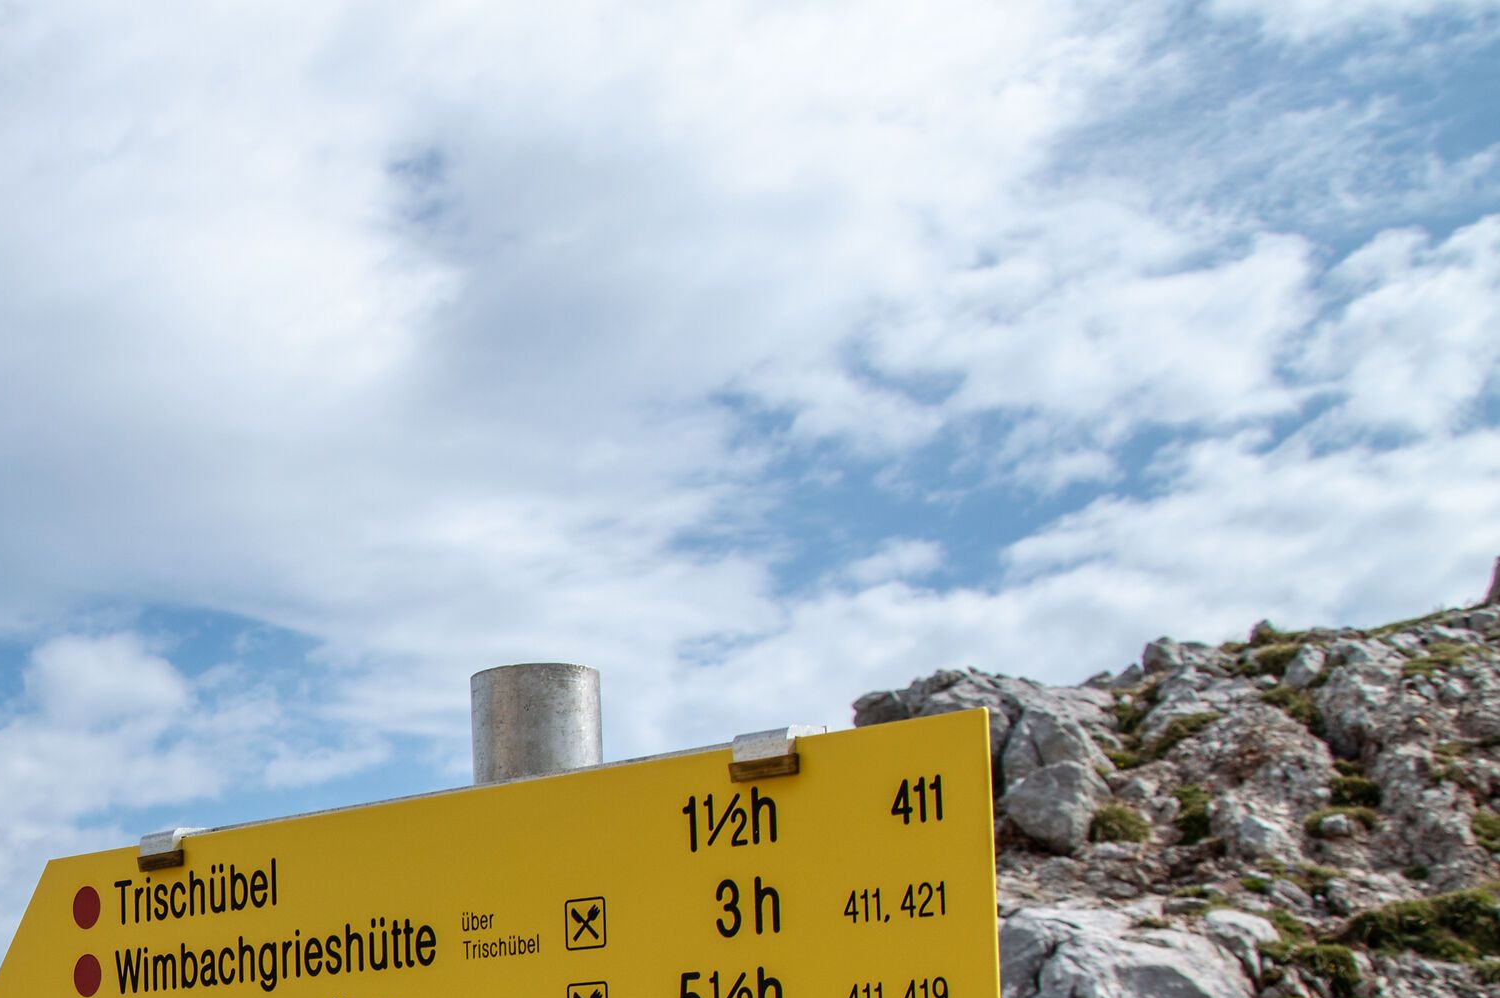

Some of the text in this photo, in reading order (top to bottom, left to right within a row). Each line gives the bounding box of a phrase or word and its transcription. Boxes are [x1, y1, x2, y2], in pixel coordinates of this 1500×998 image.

[891, 774, 943, 825] 411
[114, 858, 277, 925] Trischübel
[716, 876, 780, 938] 3 h
[901, 881, 945, 918] 421
[462, 912, 493, 931] über
[463, 934, 539, 959] Trischübel
[115, 917, 436, 994] Wimbachgrieshütte
